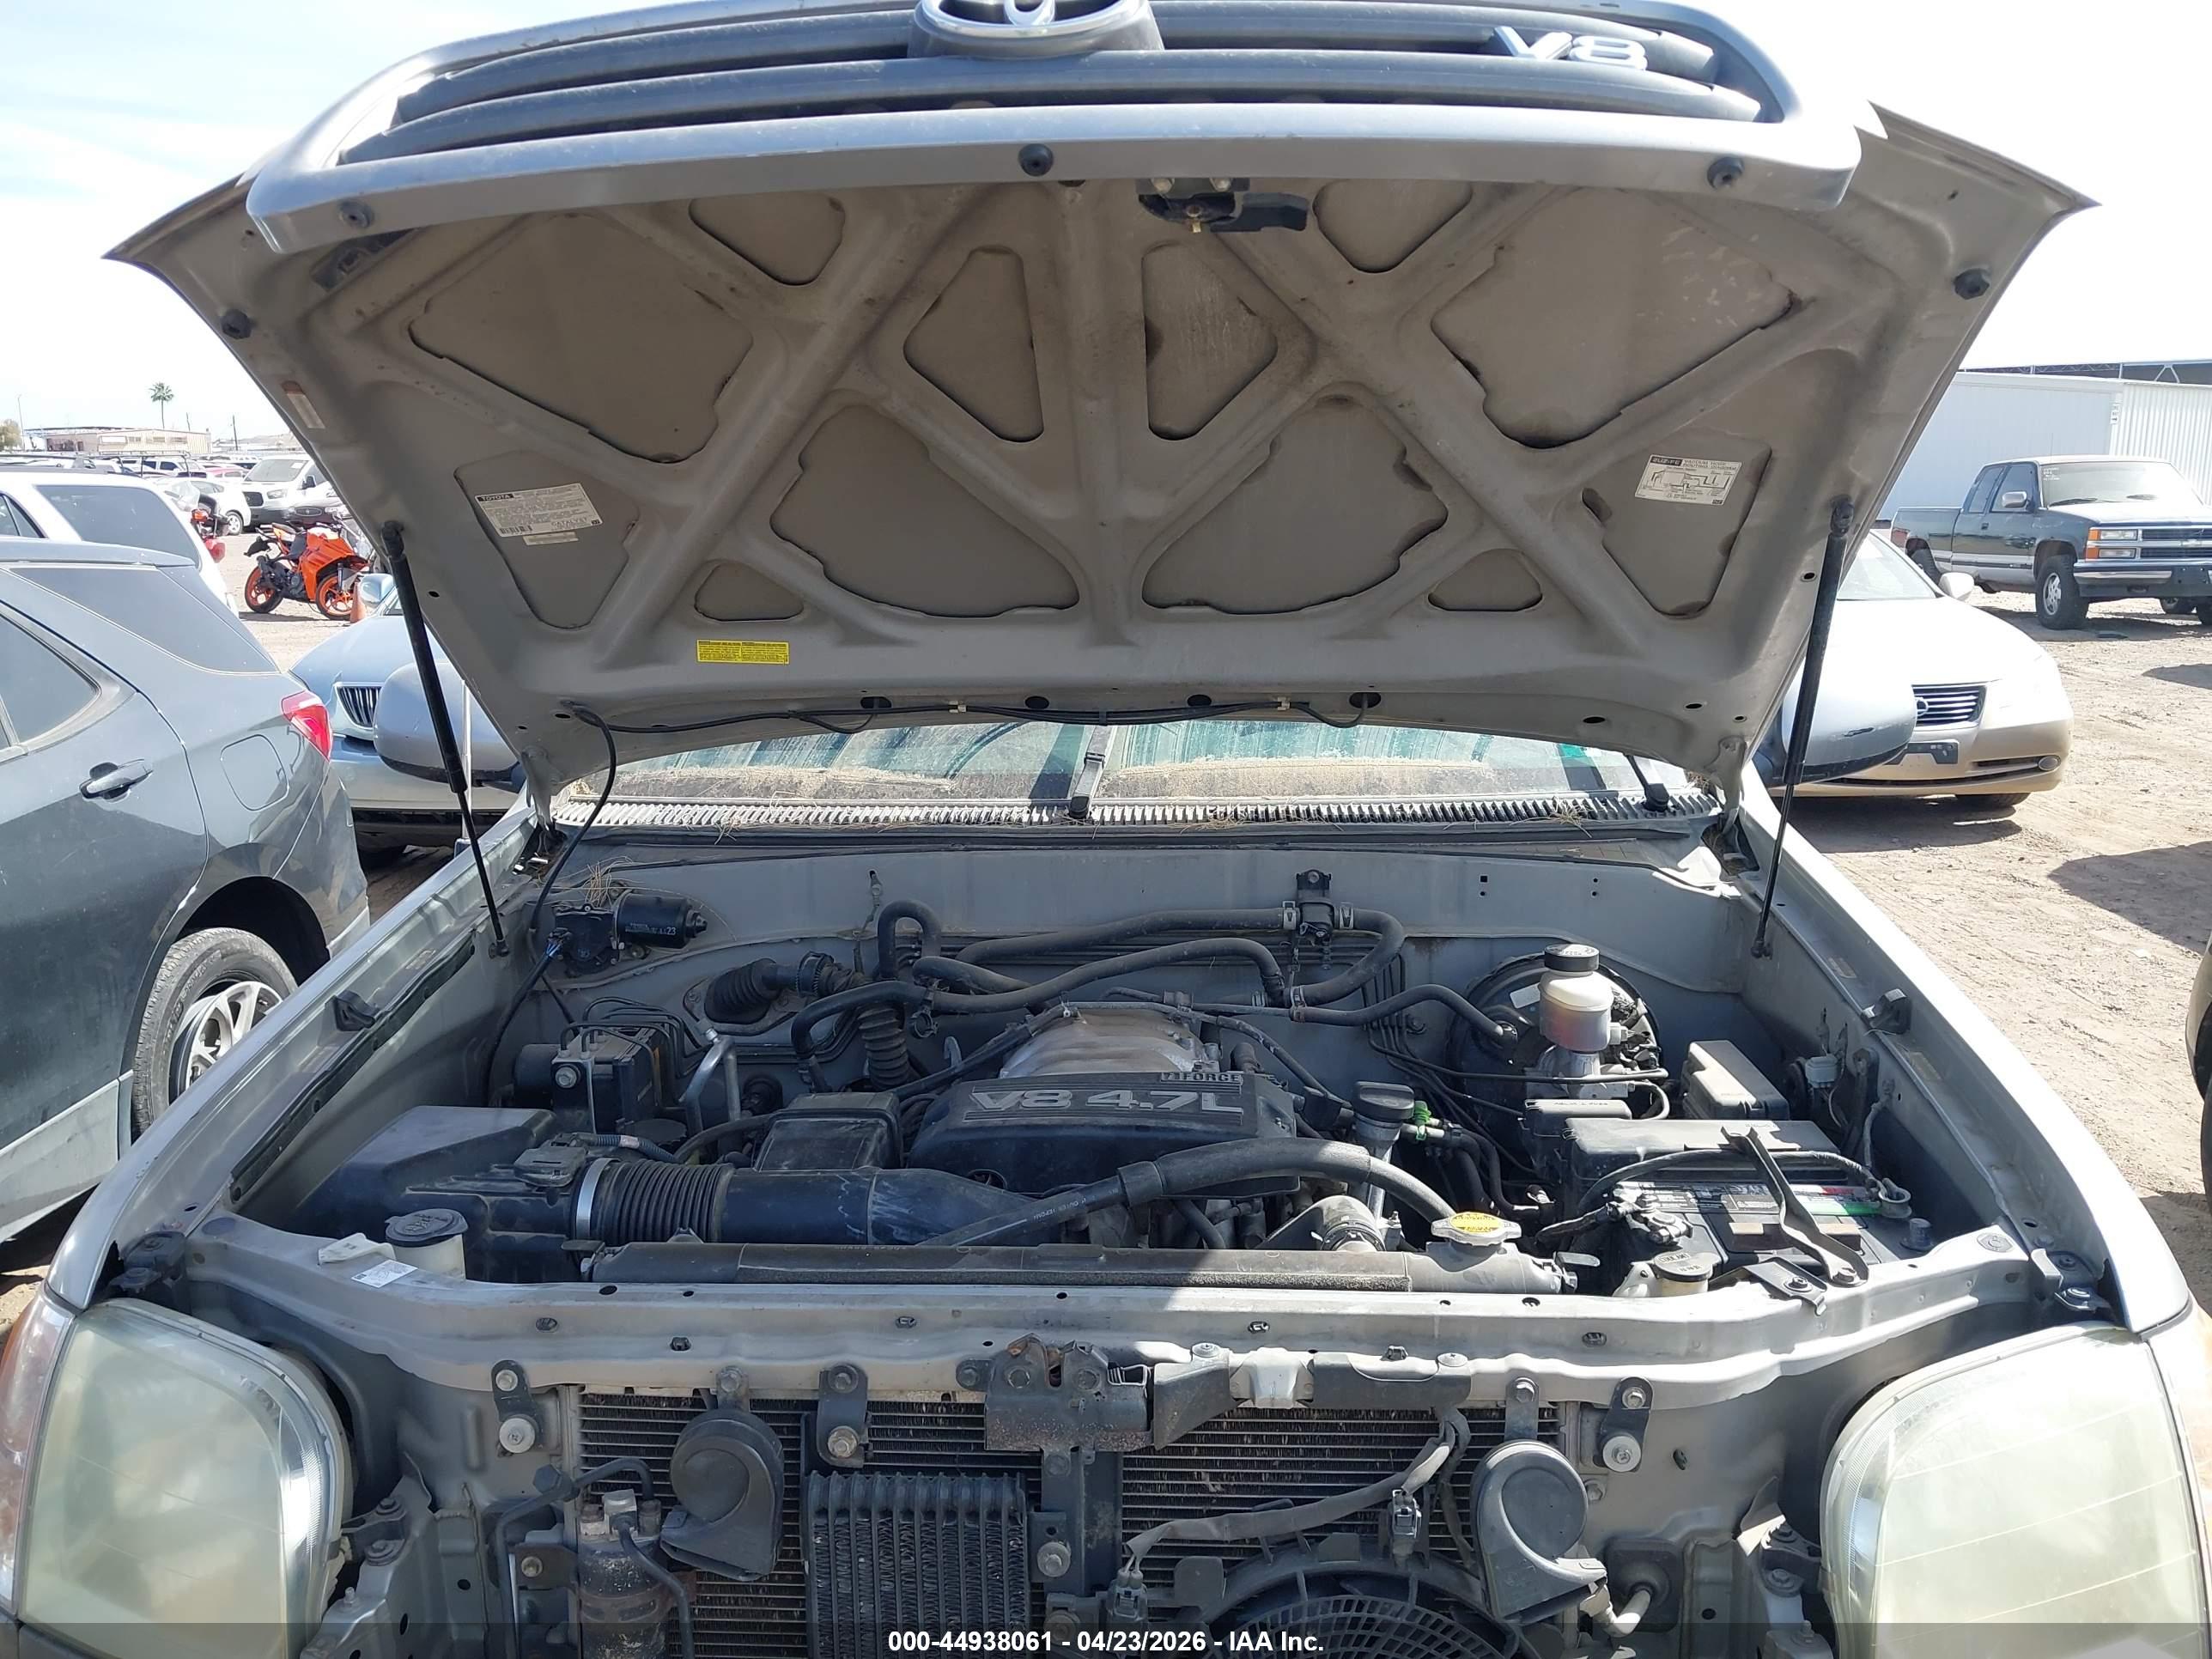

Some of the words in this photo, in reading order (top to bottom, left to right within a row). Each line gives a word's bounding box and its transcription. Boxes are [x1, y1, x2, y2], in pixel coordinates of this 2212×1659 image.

[1494, 25, 1648, 70] V8
[969, 1089, 1073, 1111] V8
[1085, 1089, 1243, 1115] 4.7L
